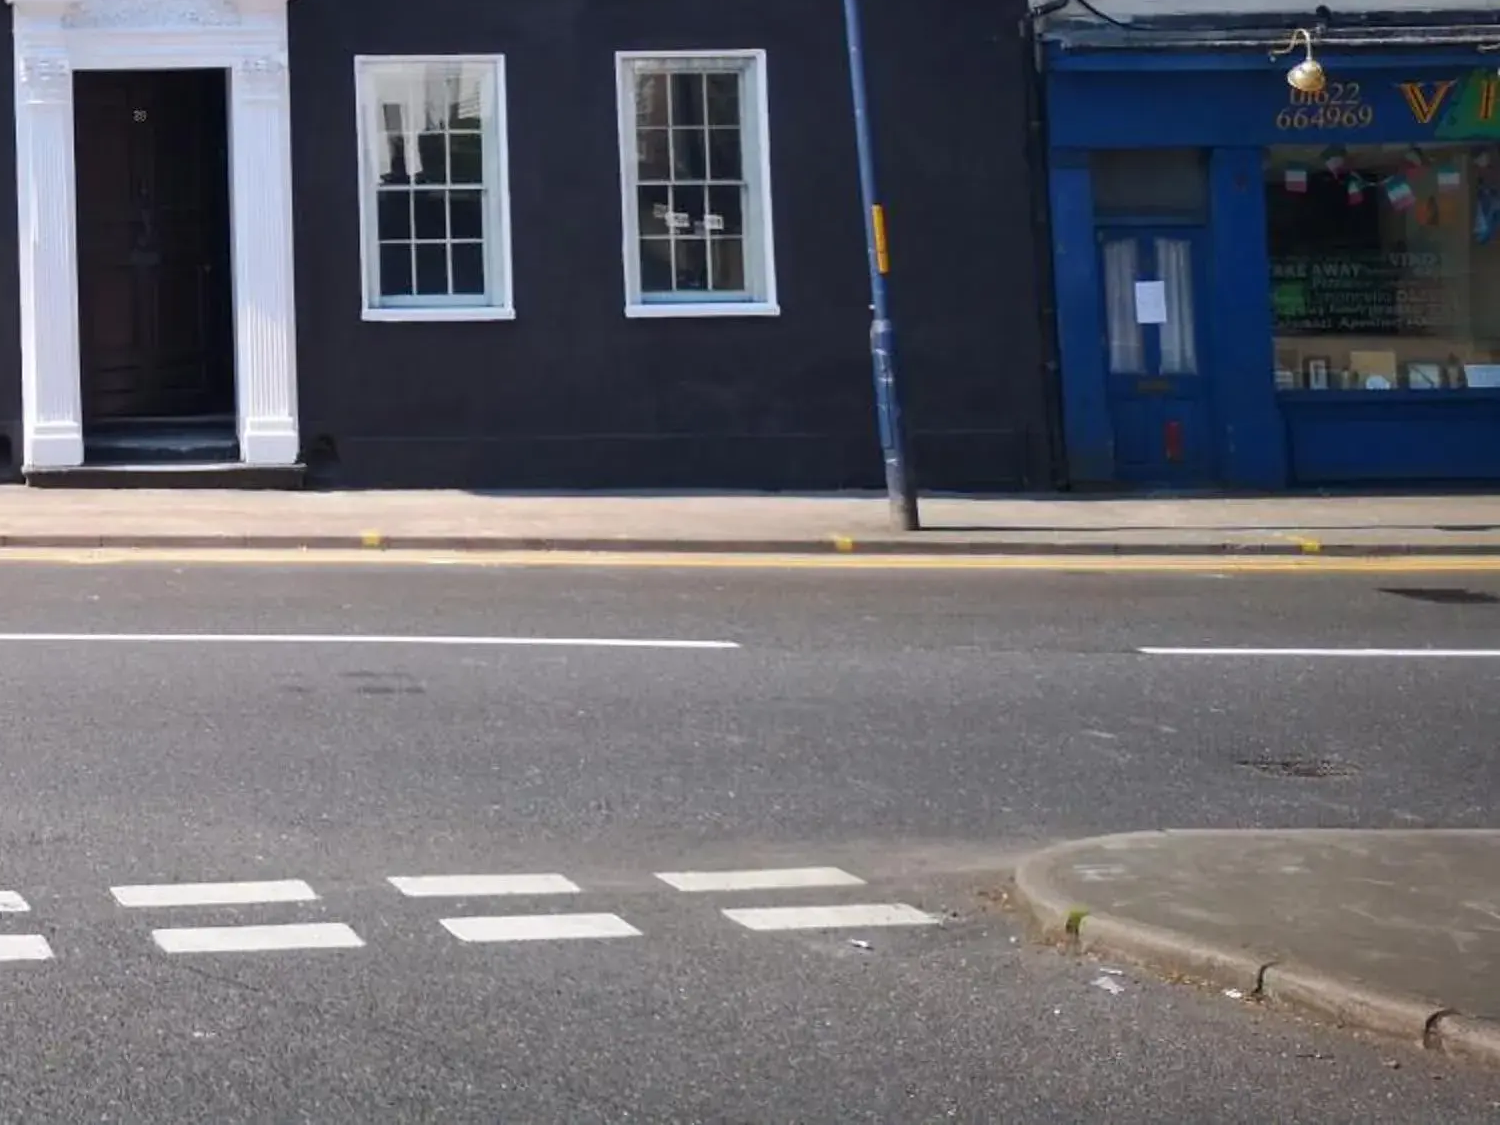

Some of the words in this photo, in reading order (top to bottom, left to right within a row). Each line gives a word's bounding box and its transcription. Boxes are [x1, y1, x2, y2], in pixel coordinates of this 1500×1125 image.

[1275, 104, 1373, 131] 664969
[1272, 262, 1307, 278] AKE
[1312, 262, 1361, 278] AWAY
